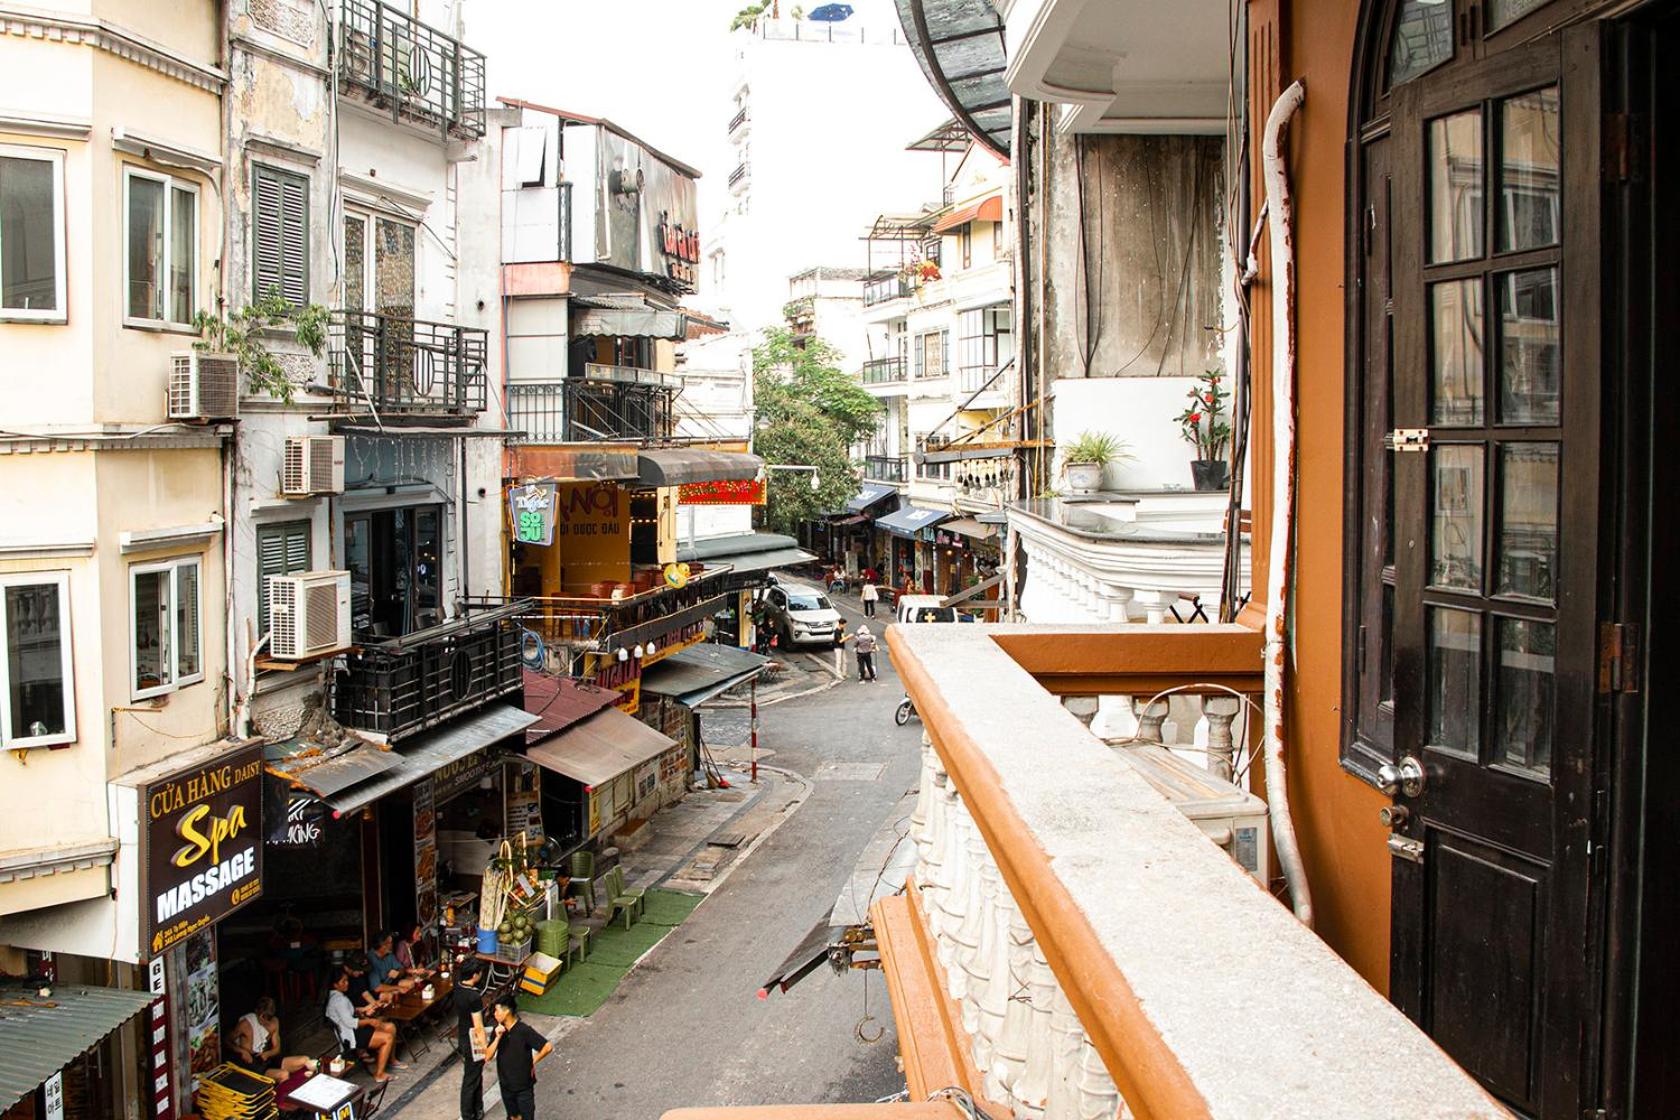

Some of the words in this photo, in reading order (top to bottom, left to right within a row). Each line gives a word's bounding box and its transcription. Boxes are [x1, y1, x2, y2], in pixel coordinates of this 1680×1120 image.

[150, 783, 185, 818] CỬA
[187, 766, 231, 804] HÀNG
[173, 804, 247, 867] Spa
[157, 846, 255, 924] MASSAGE
